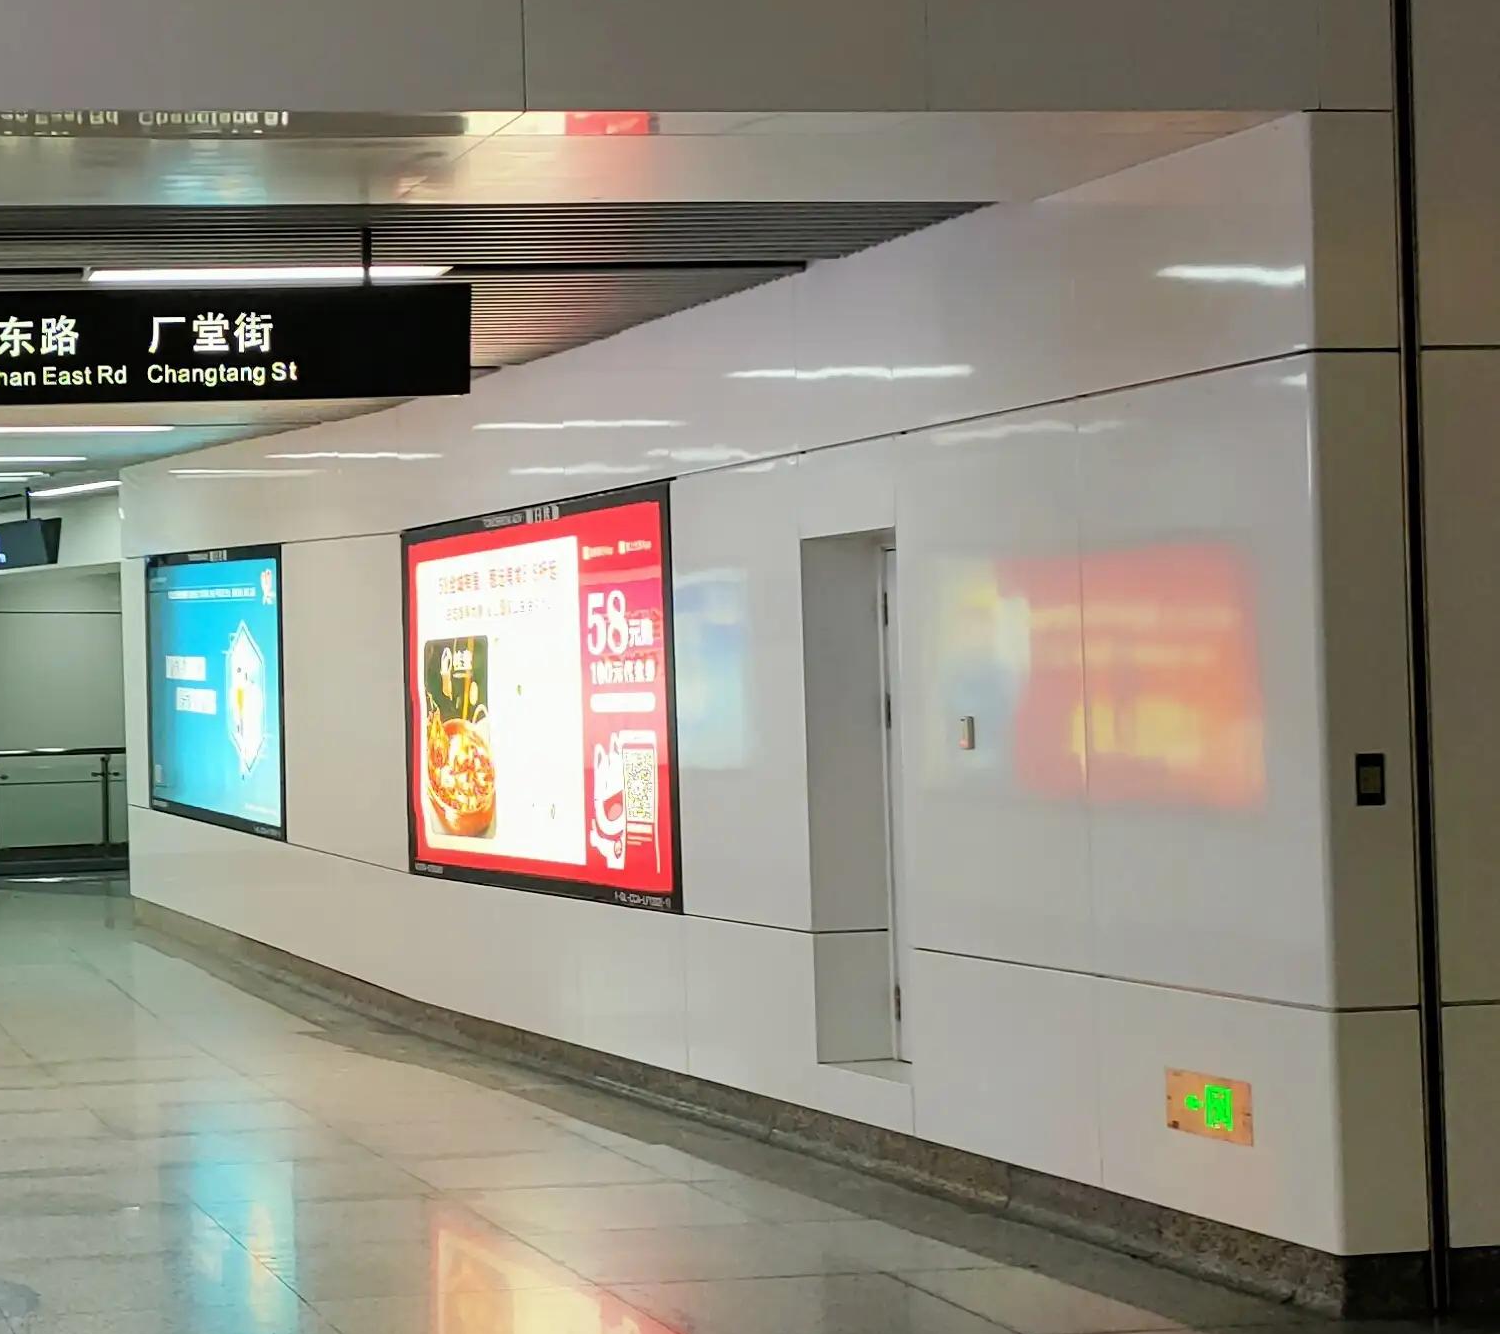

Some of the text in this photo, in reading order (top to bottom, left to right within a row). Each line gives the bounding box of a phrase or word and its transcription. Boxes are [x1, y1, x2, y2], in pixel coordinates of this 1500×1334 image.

[148, 311, 274, 355] 厂堂街
[42, 366, 92, 386] East
[97, 364, 127, 385] Rd
[147, 364, 266, 387] Changtang
[271, 361, 298, 382] St
